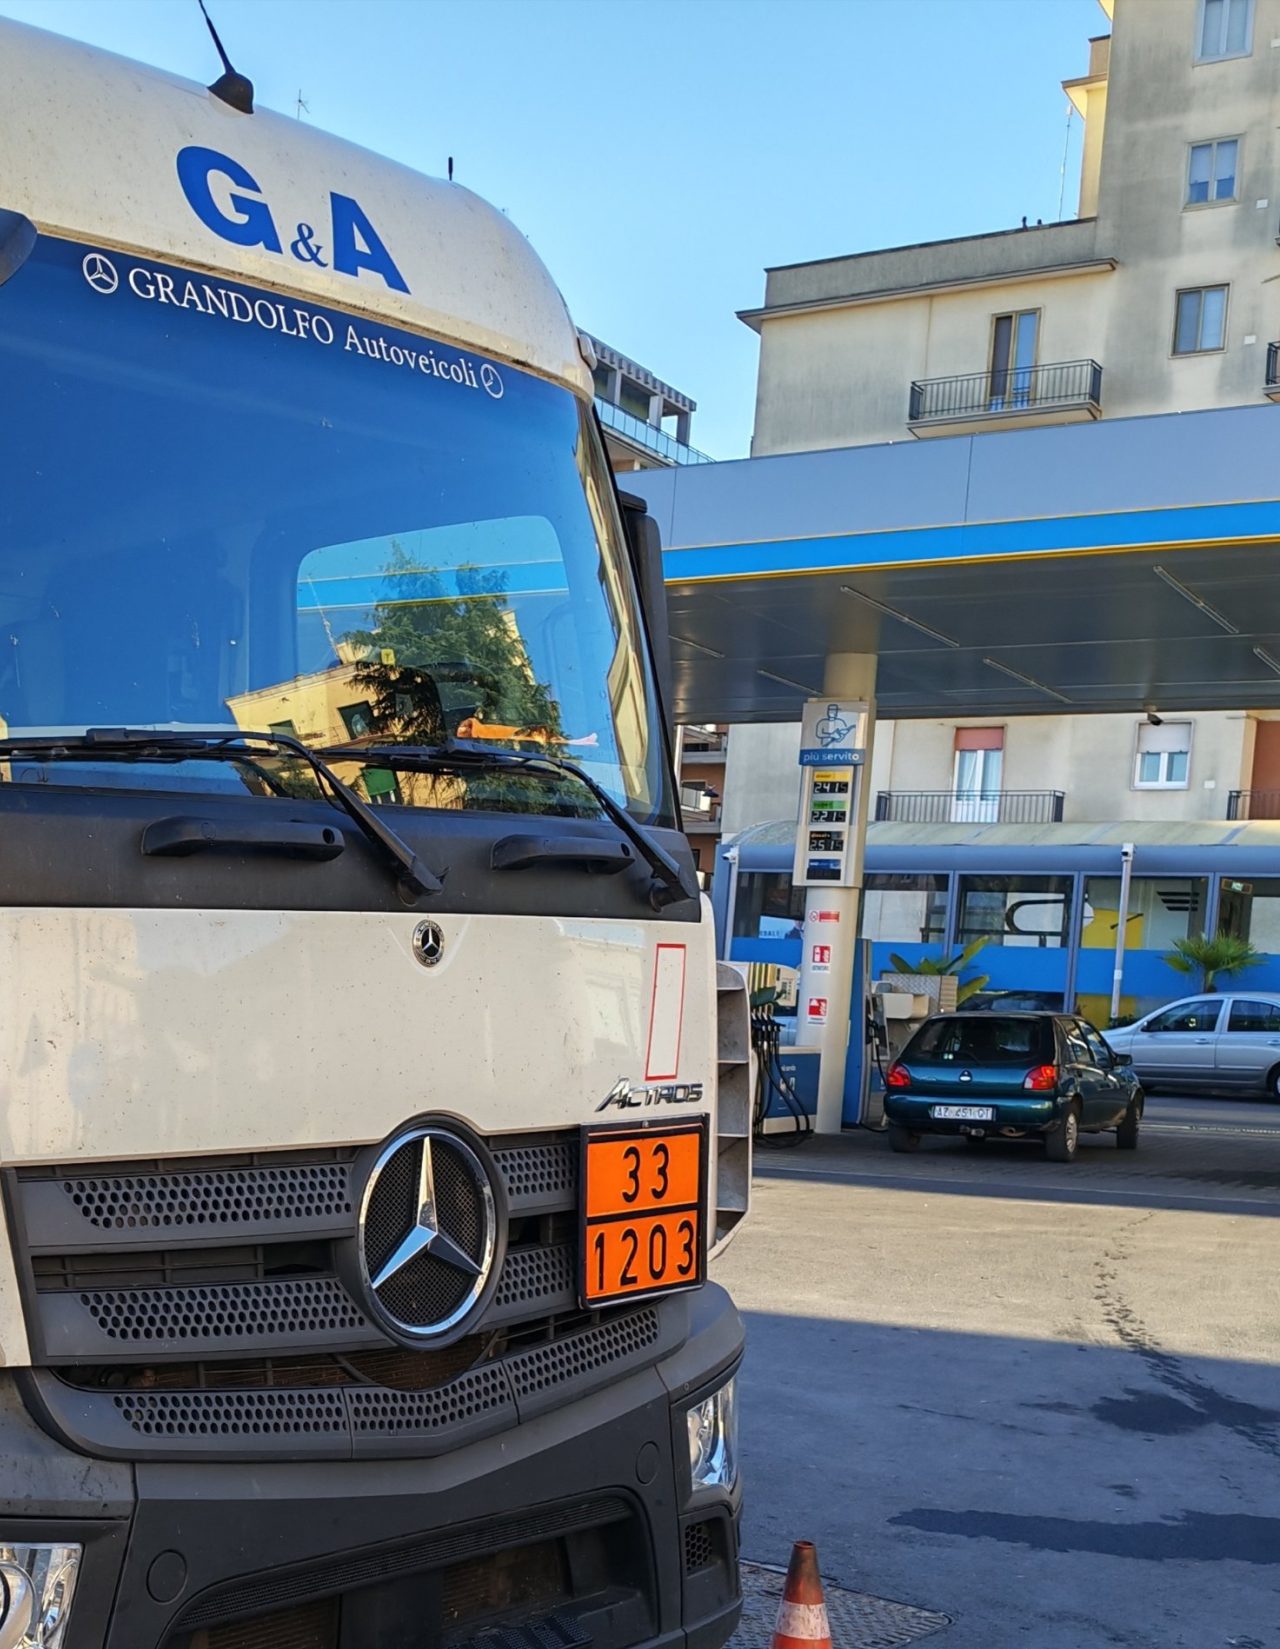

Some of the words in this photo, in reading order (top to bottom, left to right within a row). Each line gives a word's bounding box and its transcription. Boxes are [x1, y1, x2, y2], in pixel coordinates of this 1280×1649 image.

[176, 145, 412, 295] G&A
[127, 268, 334, 345] GRANDOLFO
[344, 324, 479, 389] Autoveicoli
[803, 751, 820, 763] più
[822, 751, 859, 761] servito
[621, 1142, 670, 1203] 33
[594, 1219, 695, 1292] 1203
